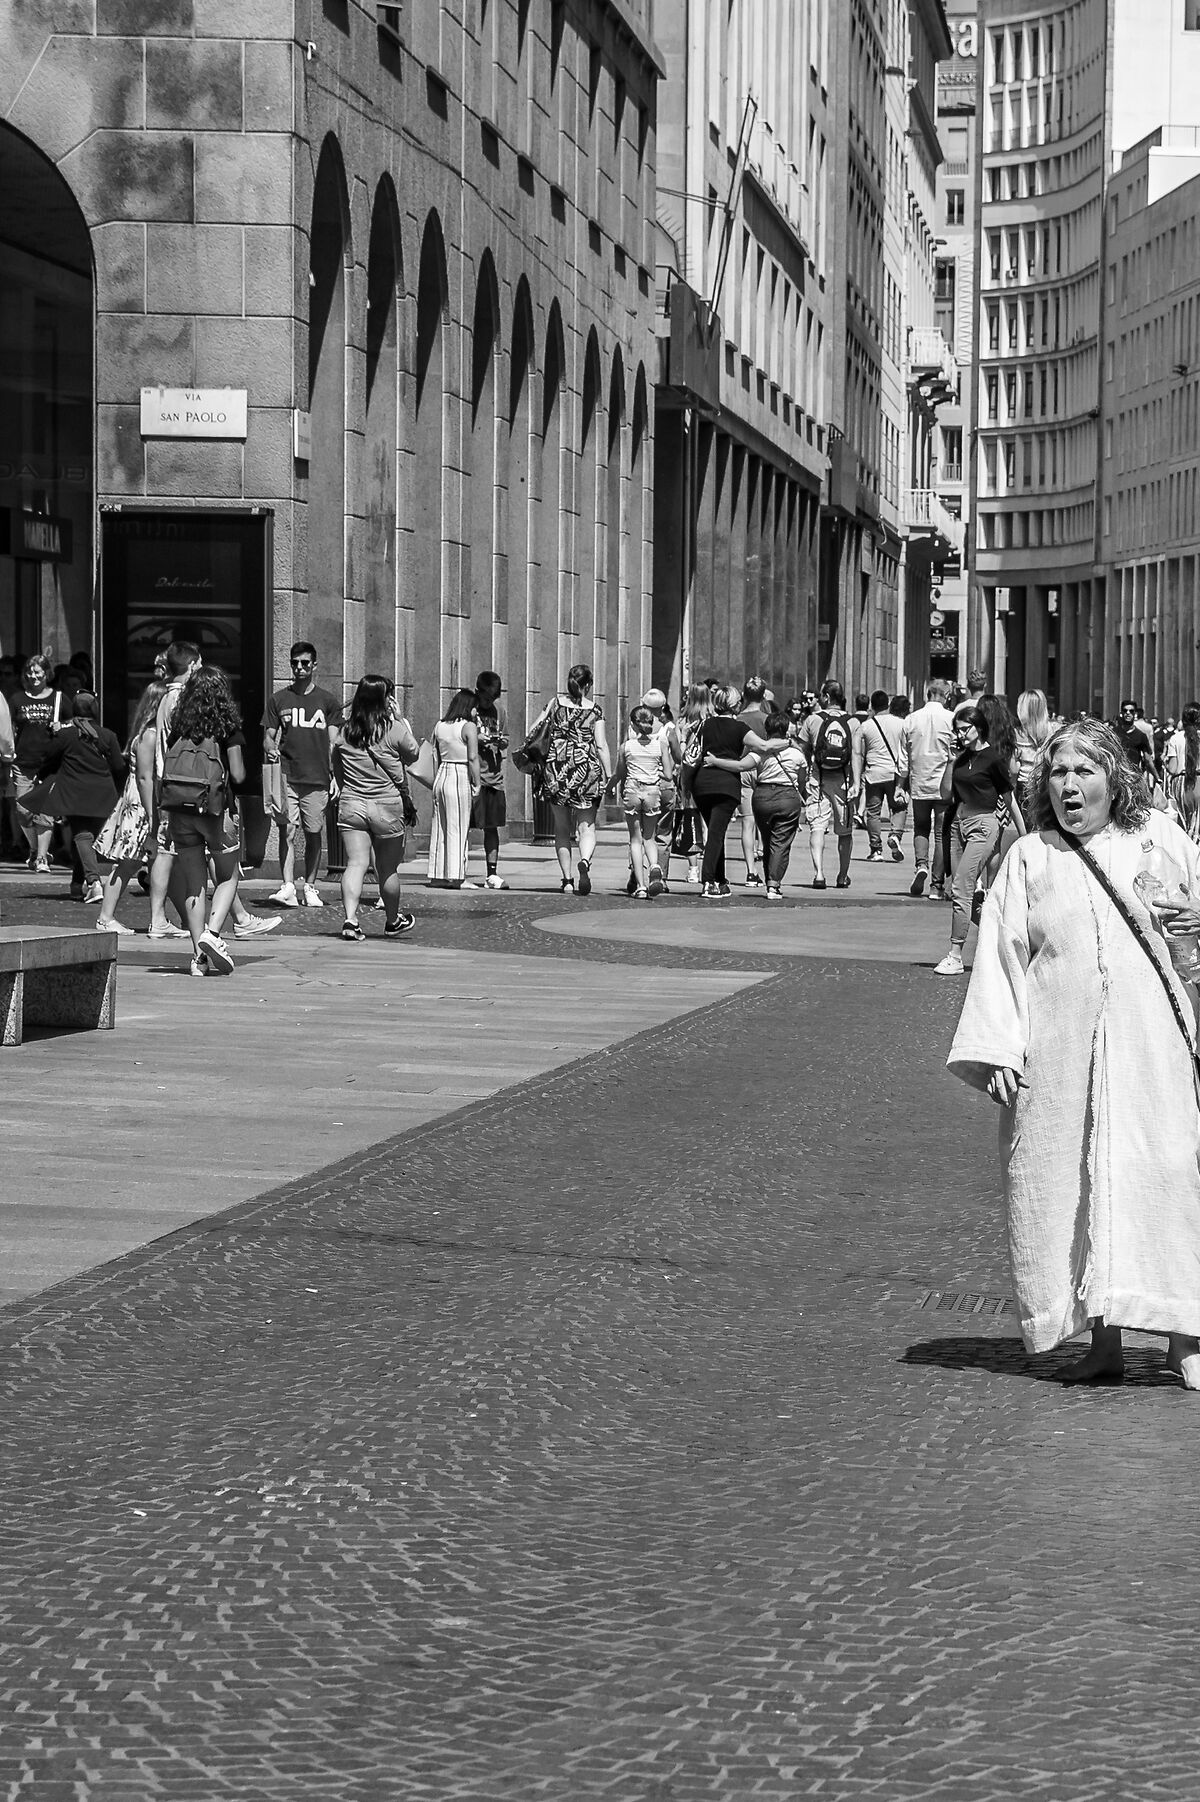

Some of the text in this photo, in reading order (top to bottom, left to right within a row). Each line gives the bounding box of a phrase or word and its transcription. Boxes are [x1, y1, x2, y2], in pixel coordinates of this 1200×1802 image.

[185, 393, 202, 401] VIA
[160, 411, 227, 423] SAN PAOLO
[280, 707, 327, 730] FILA
